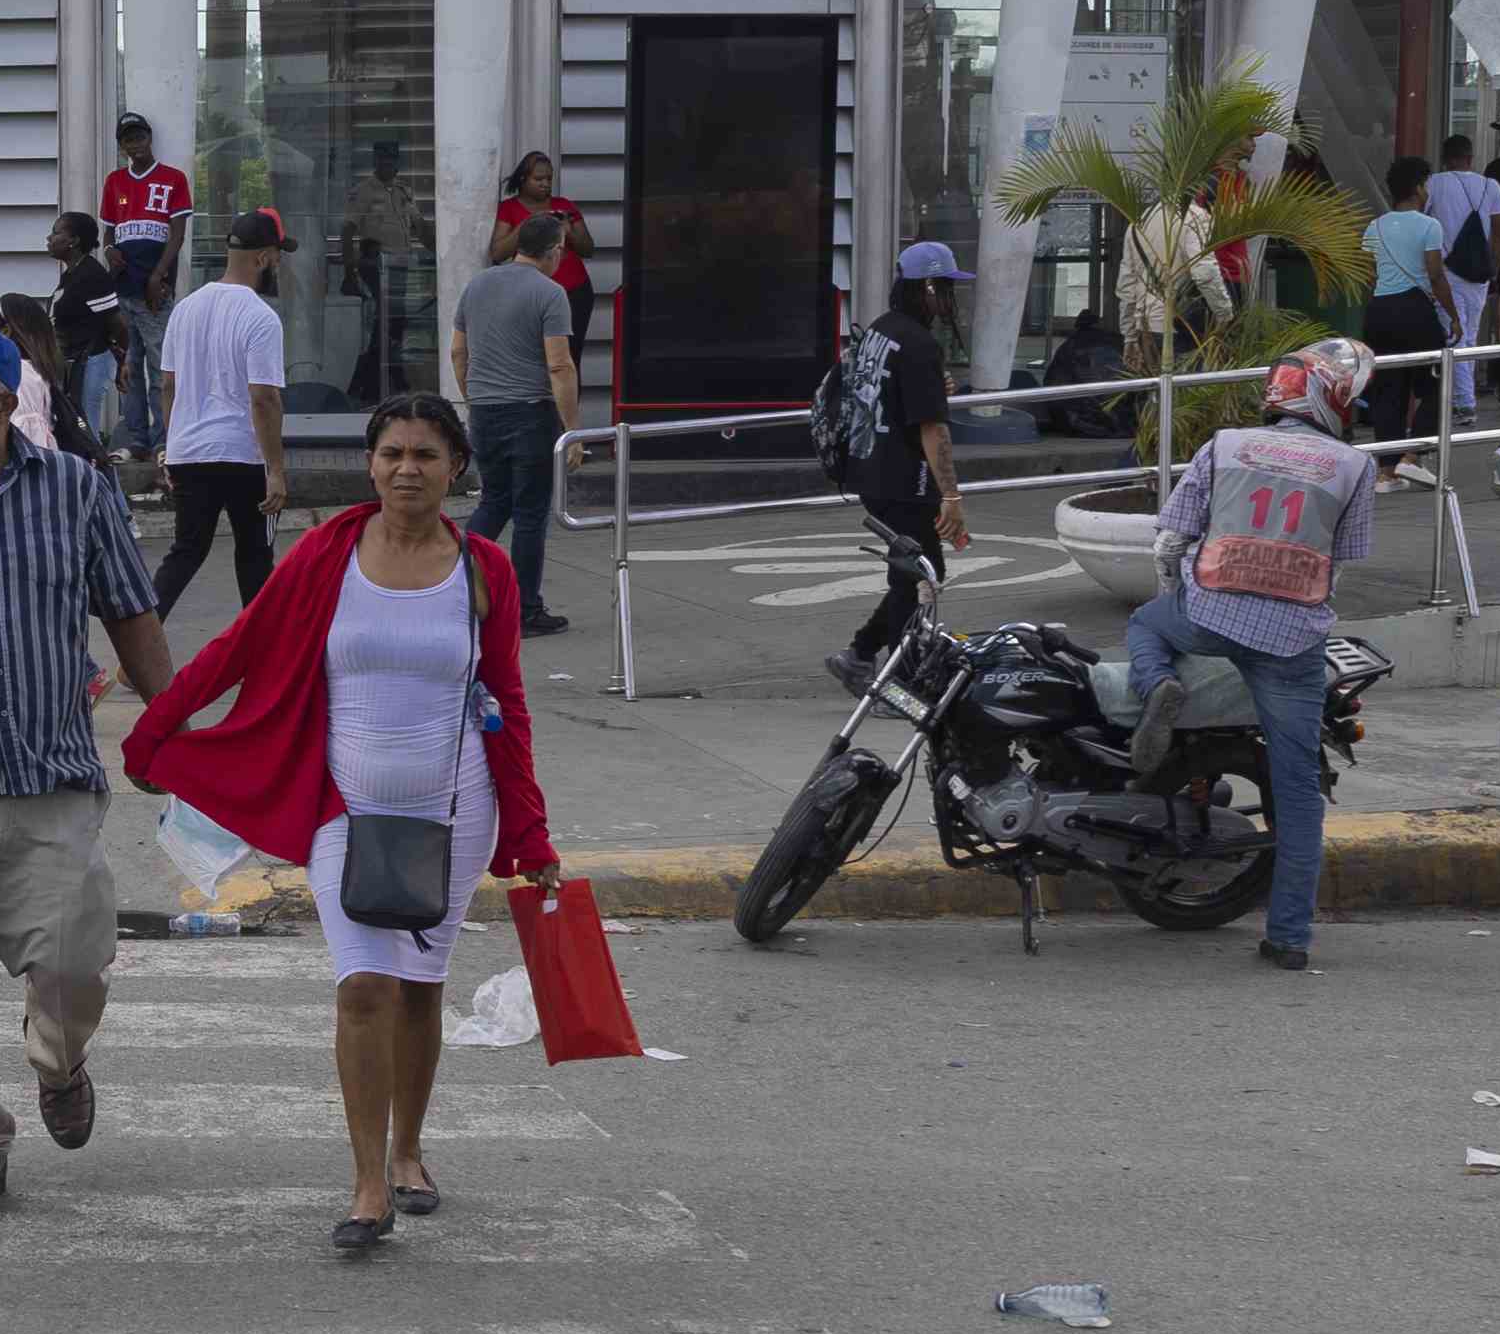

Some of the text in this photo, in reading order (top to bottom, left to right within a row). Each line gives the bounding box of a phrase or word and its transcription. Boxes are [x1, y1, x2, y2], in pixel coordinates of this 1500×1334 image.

[145, 183, 174, 213] H
[1248, 486, 1306, 535] 11
[983, 672, 1045, 686] BOXER
